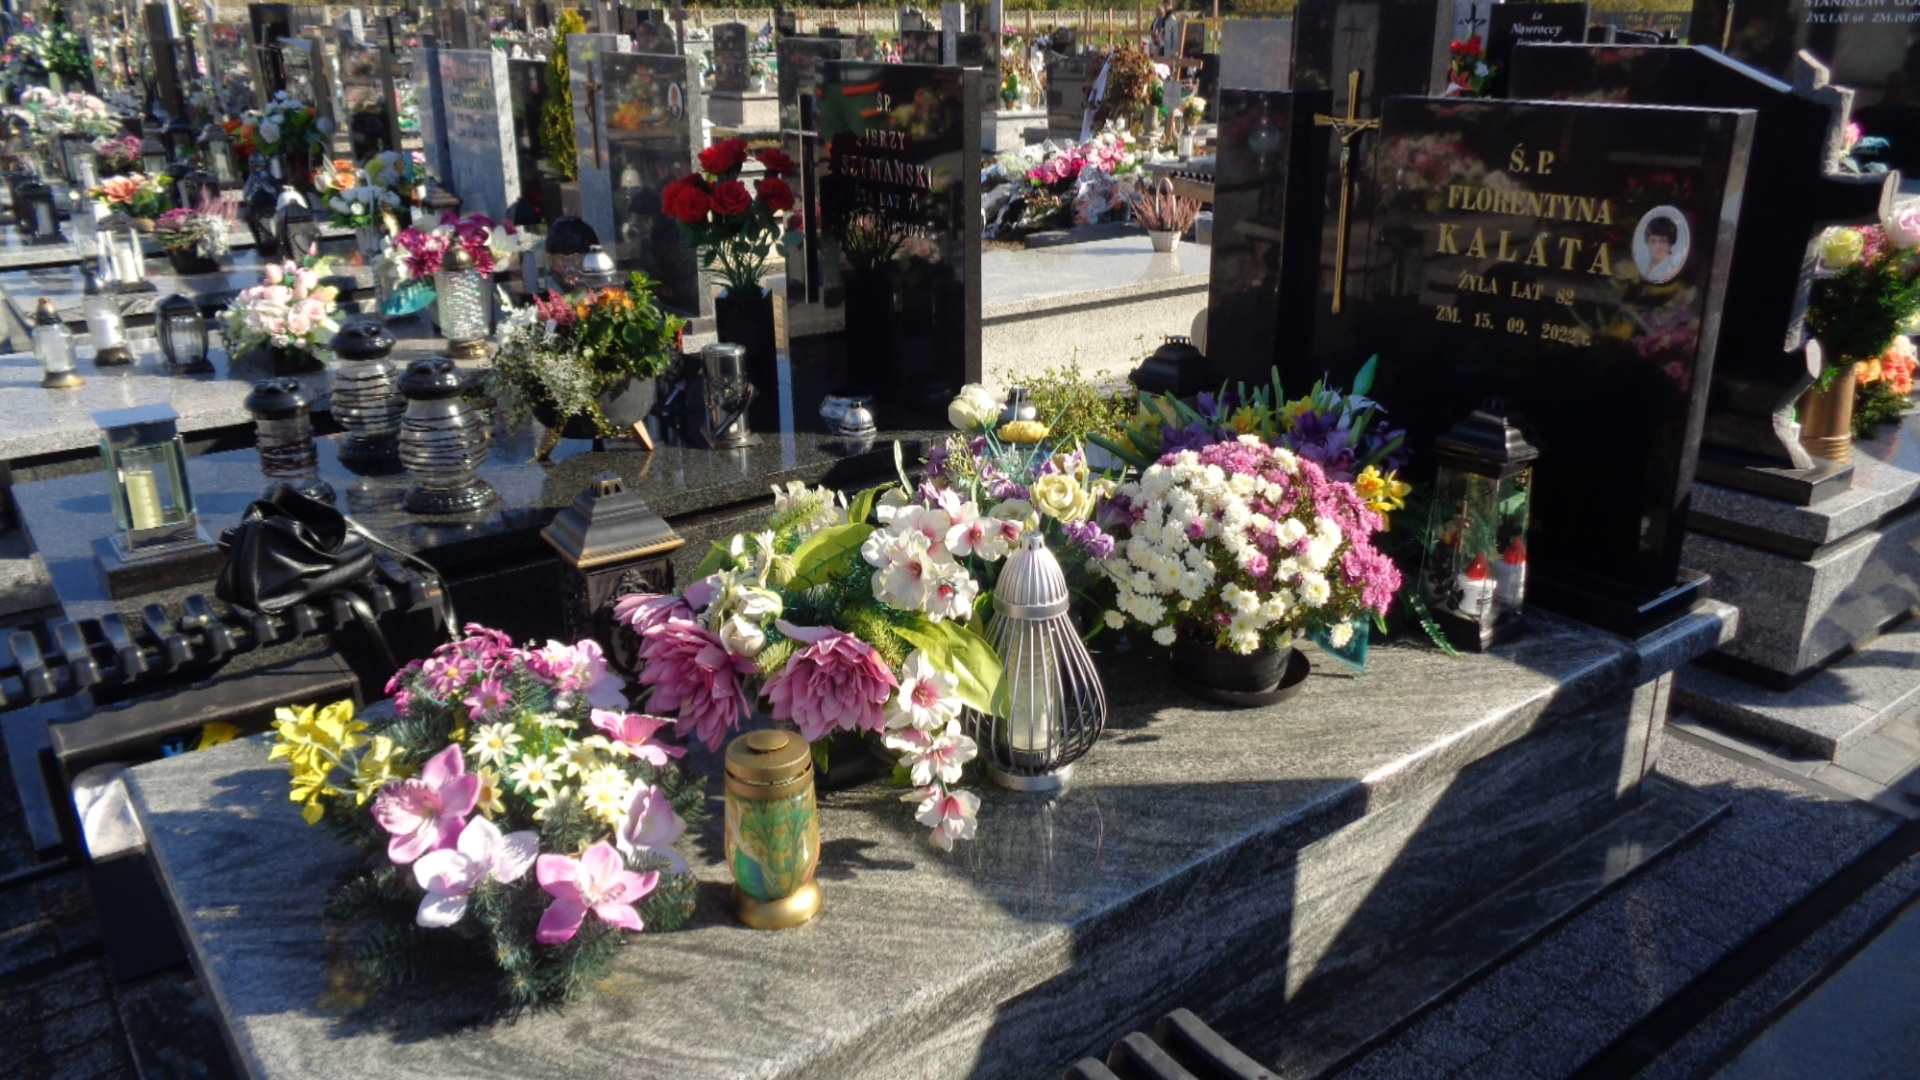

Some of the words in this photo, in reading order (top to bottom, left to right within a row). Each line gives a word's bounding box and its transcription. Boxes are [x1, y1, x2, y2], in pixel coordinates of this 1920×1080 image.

[865, 128, 905, 150] JERZY
[1448, 184, 1612, 225] FLORENTYNA
[1436, 223, 1612, 276] KALATA
[1458, 270, 1498, 294] ŻYŁA
[1511, 281, 1544, 301] LAT
[1555, 288, 1575, 306] 82
[1435, 304, 1462, 324] ZM.
[1474, 312, 1494, 330] 15.
[1506, 317, 1529, 336] 09.
[1540, 322, 1577, 346] 2022
